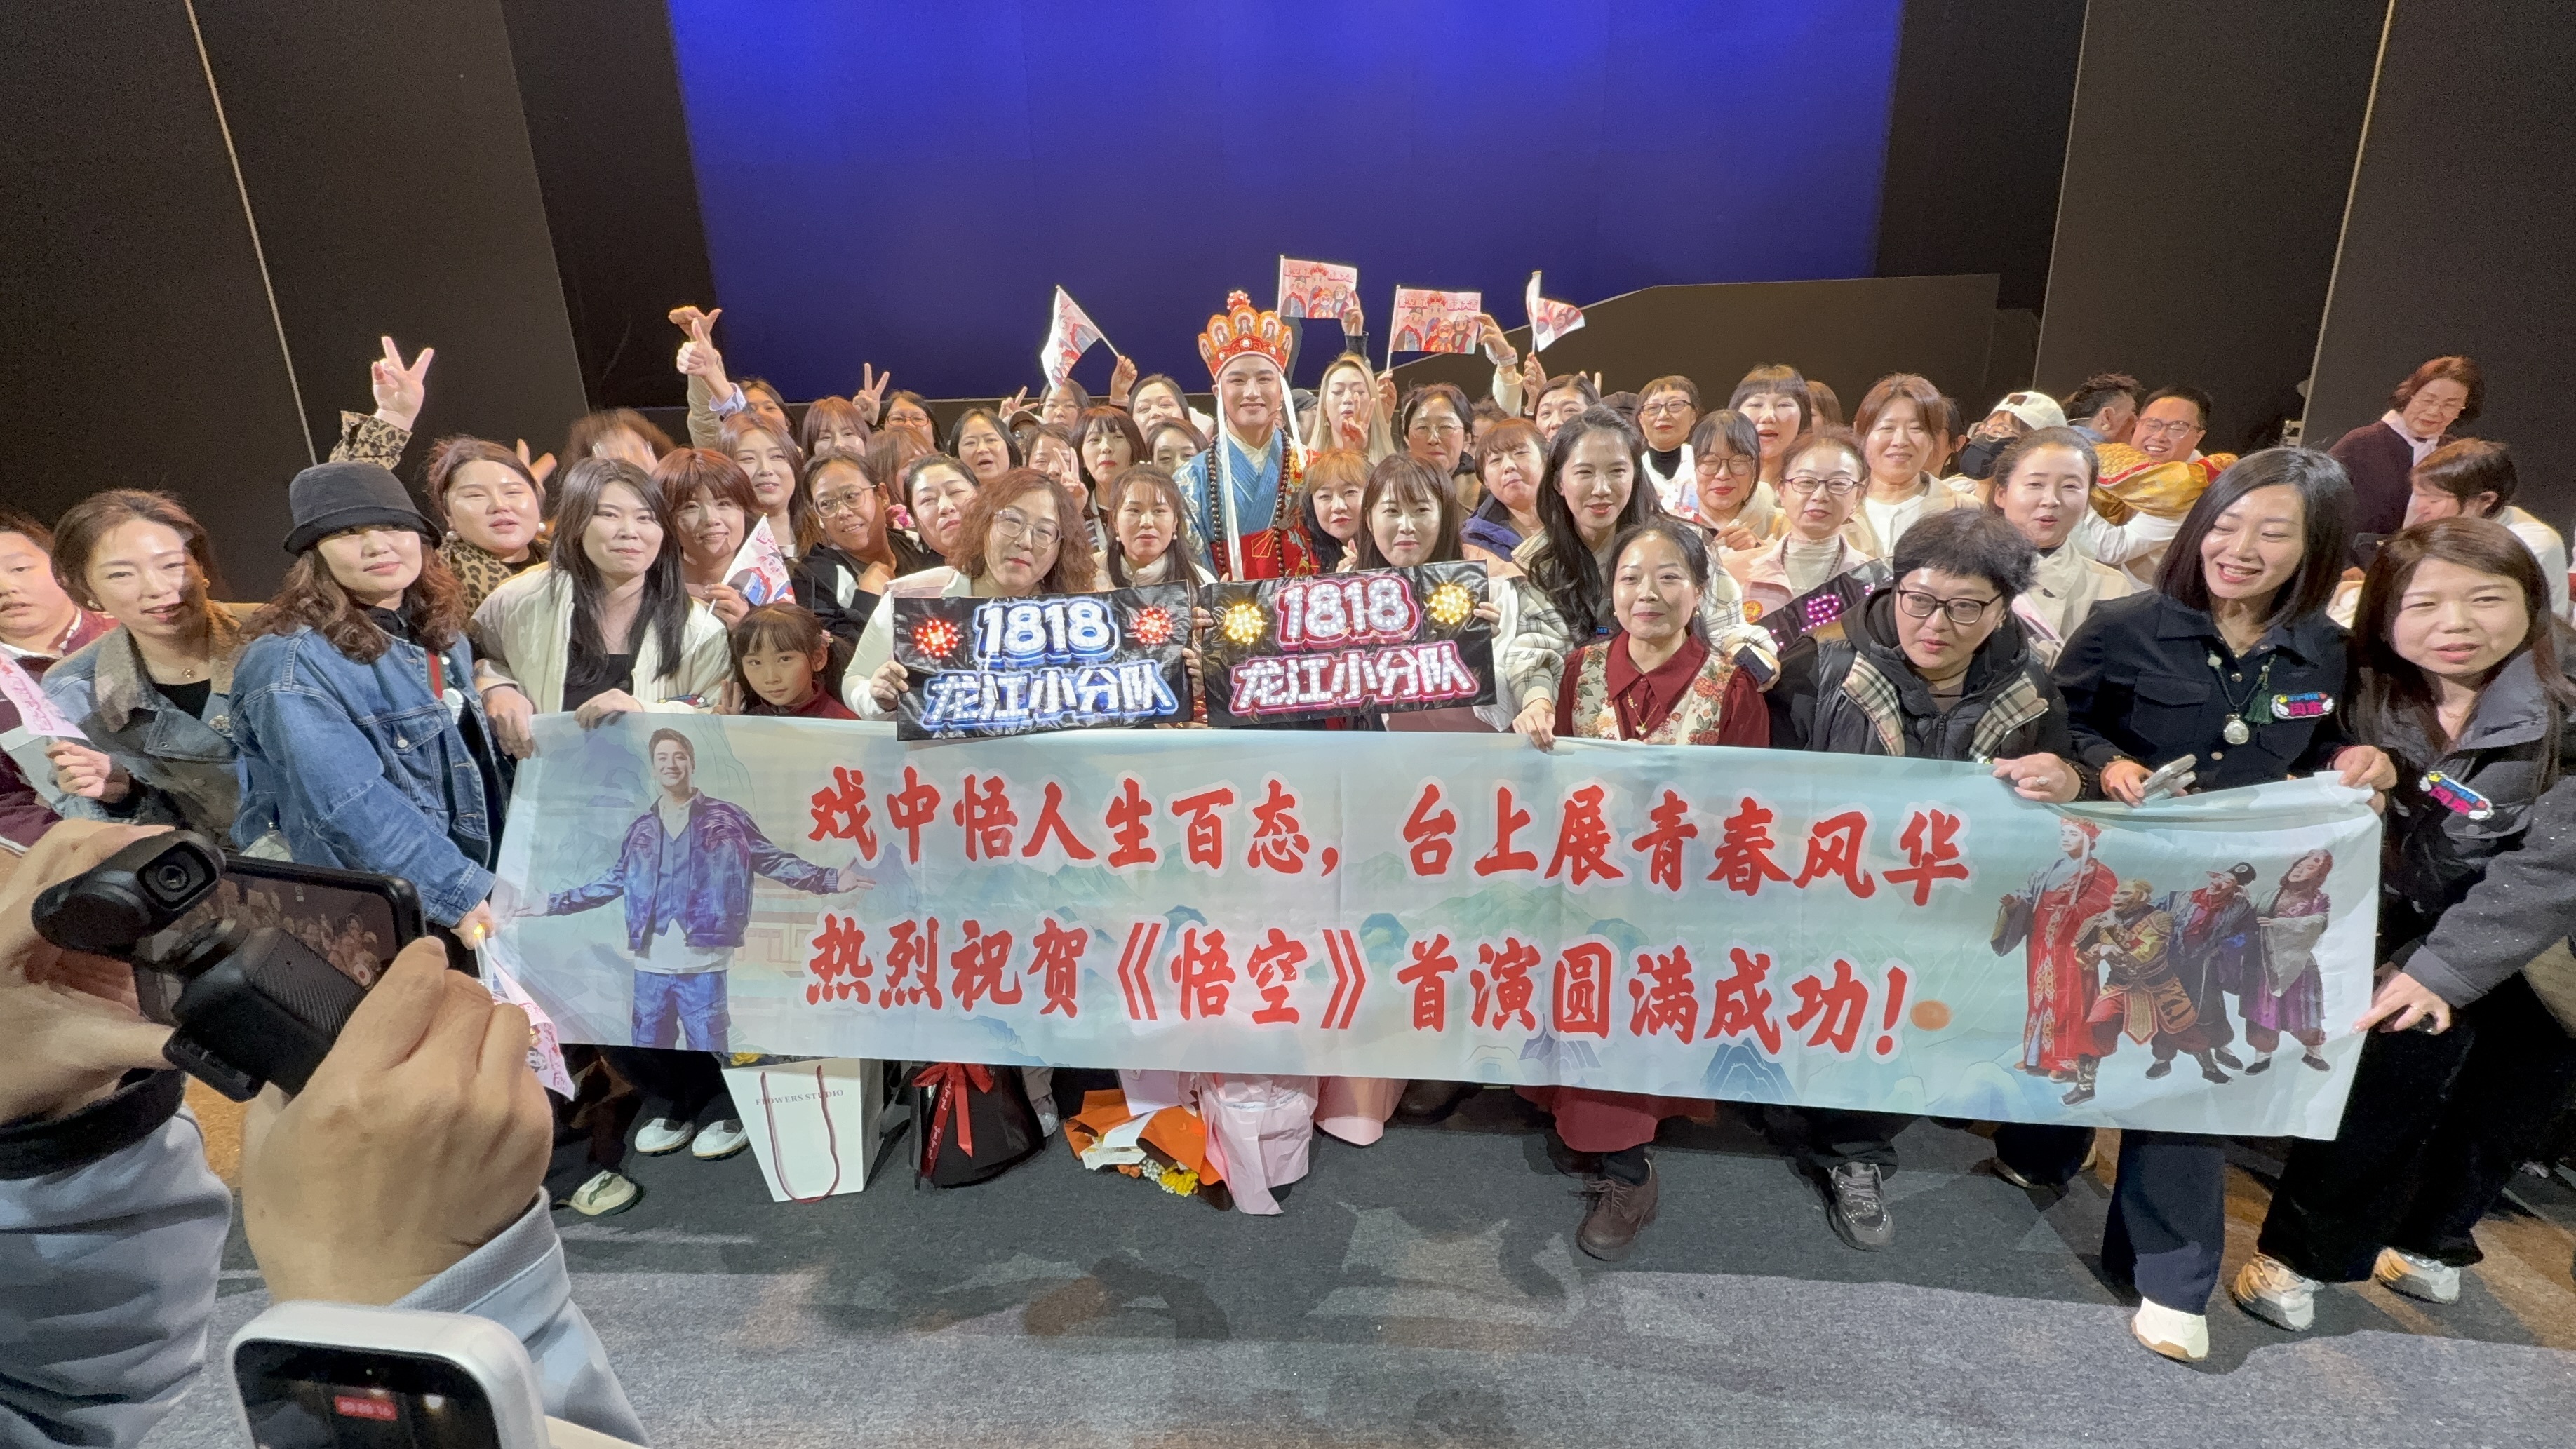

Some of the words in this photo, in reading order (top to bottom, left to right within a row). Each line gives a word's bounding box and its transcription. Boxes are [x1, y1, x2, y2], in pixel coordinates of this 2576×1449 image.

[979, 598, 1113, 659] 1818
[1280, 576, 1418, 648] 1818
[925, 662, 1176, 727] 龙江小分队
[1233, 641, 1476, 711] 龙江小分队
